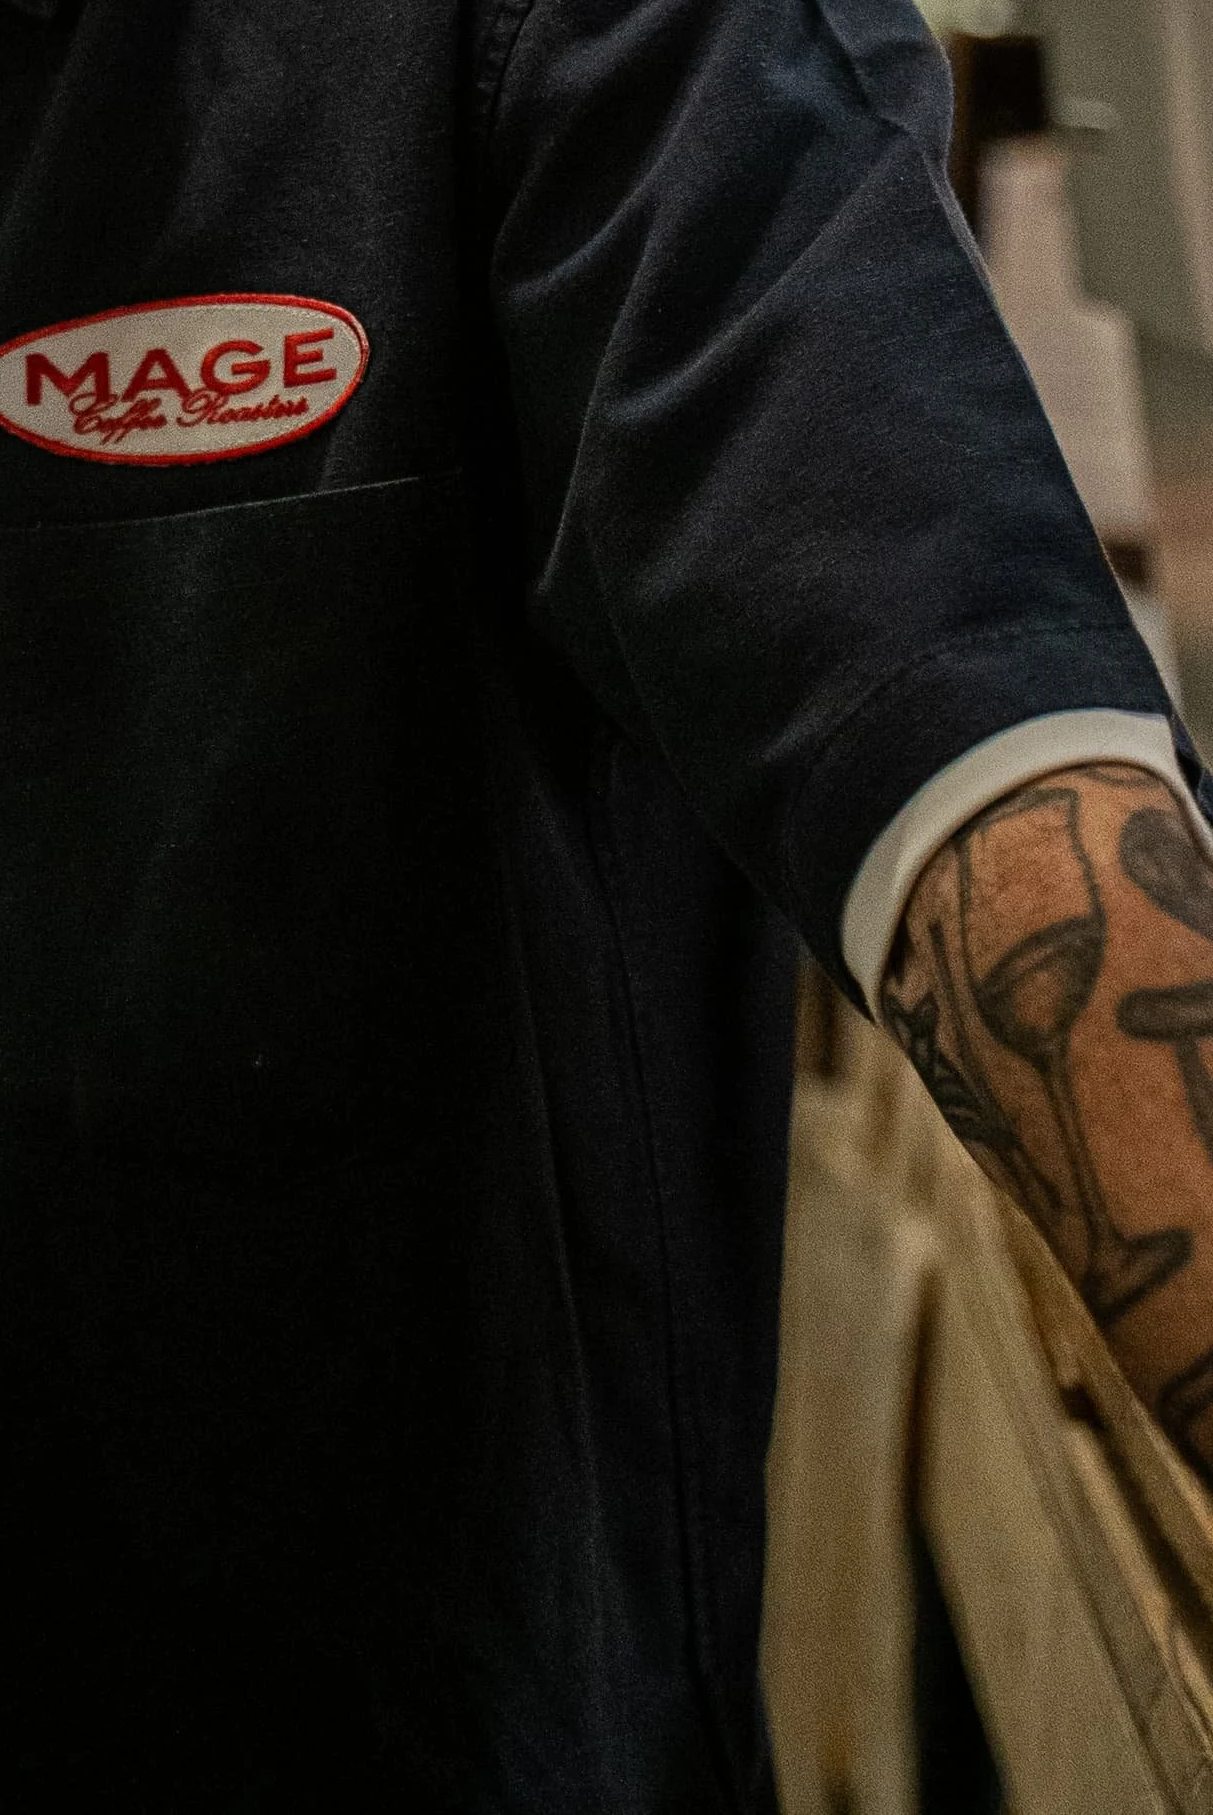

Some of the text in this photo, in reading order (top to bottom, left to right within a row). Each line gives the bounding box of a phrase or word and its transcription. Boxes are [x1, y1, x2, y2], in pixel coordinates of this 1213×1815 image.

[24, 327, 338, 407] MAGE
[68, 388, 309, 445] Coffee Roasters
